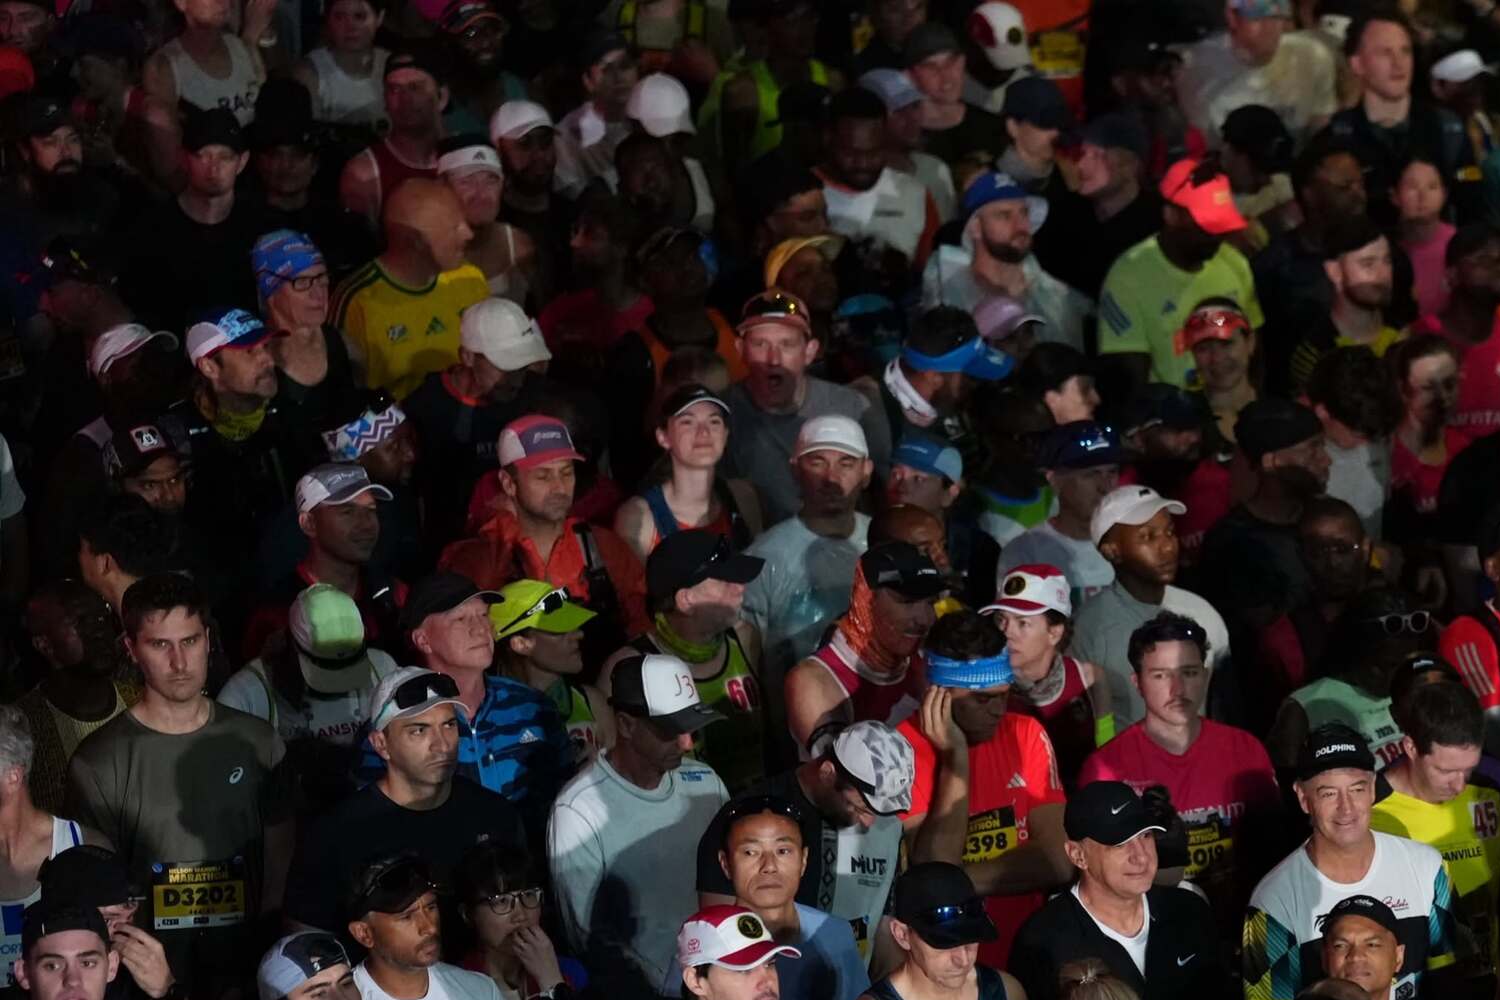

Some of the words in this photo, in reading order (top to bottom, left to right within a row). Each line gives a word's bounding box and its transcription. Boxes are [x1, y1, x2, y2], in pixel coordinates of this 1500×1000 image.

[1315, 743, 1356, 758] DOLPHINS
[1475, 801, 1497, 837] 45
[964, 832, 1008, 855] 398
[162, 887, 238, 908] D3202
